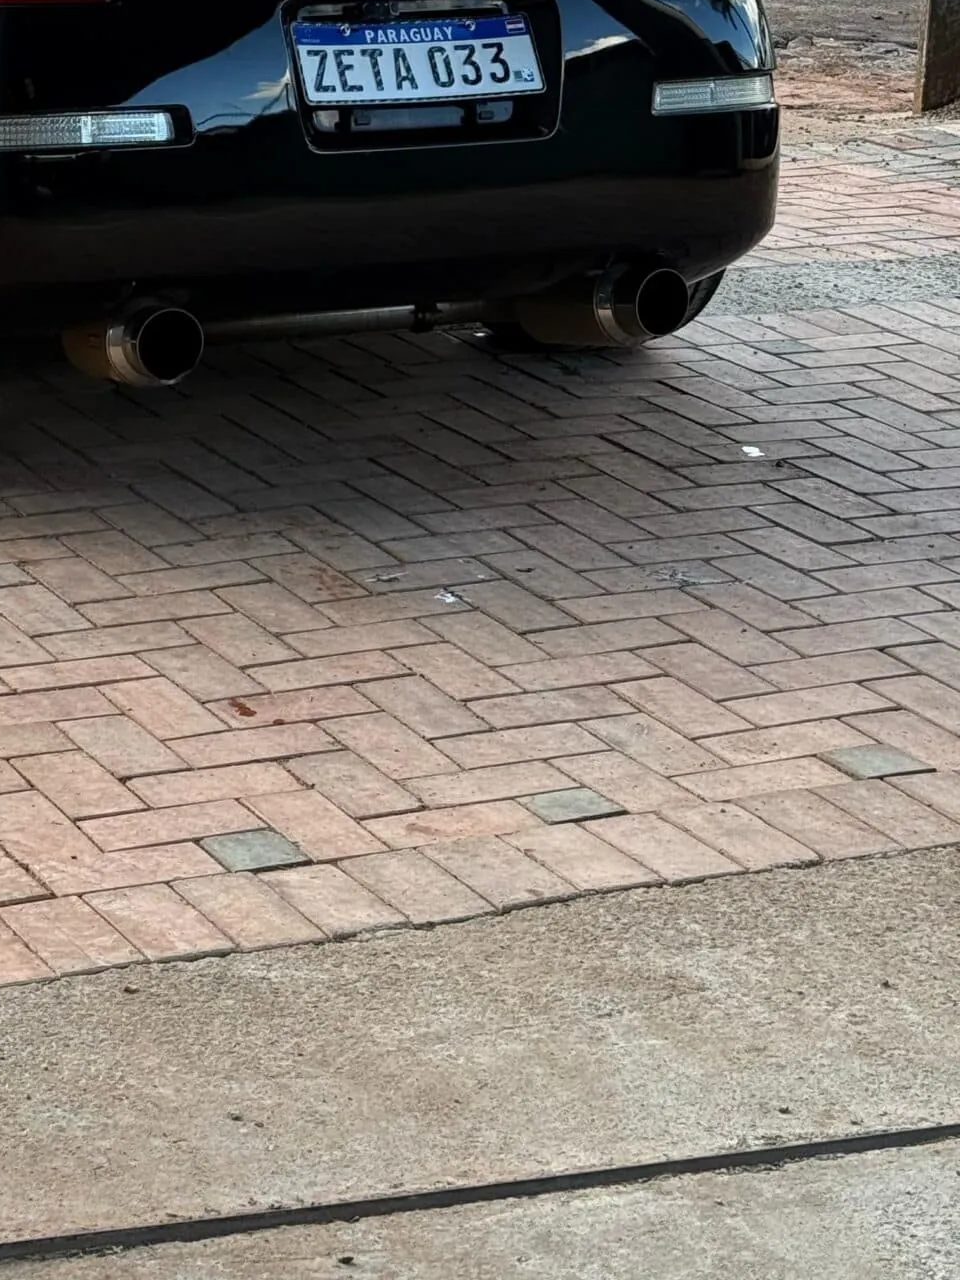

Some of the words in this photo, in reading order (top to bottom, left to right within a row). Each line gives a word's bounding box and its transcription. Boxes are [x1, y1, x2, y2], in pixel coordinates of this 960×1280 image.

[365, 26, 453, 44] PARAGUAY
[307, 47, 419, 93] ZETA
[427, 42, 511, 89] 033
